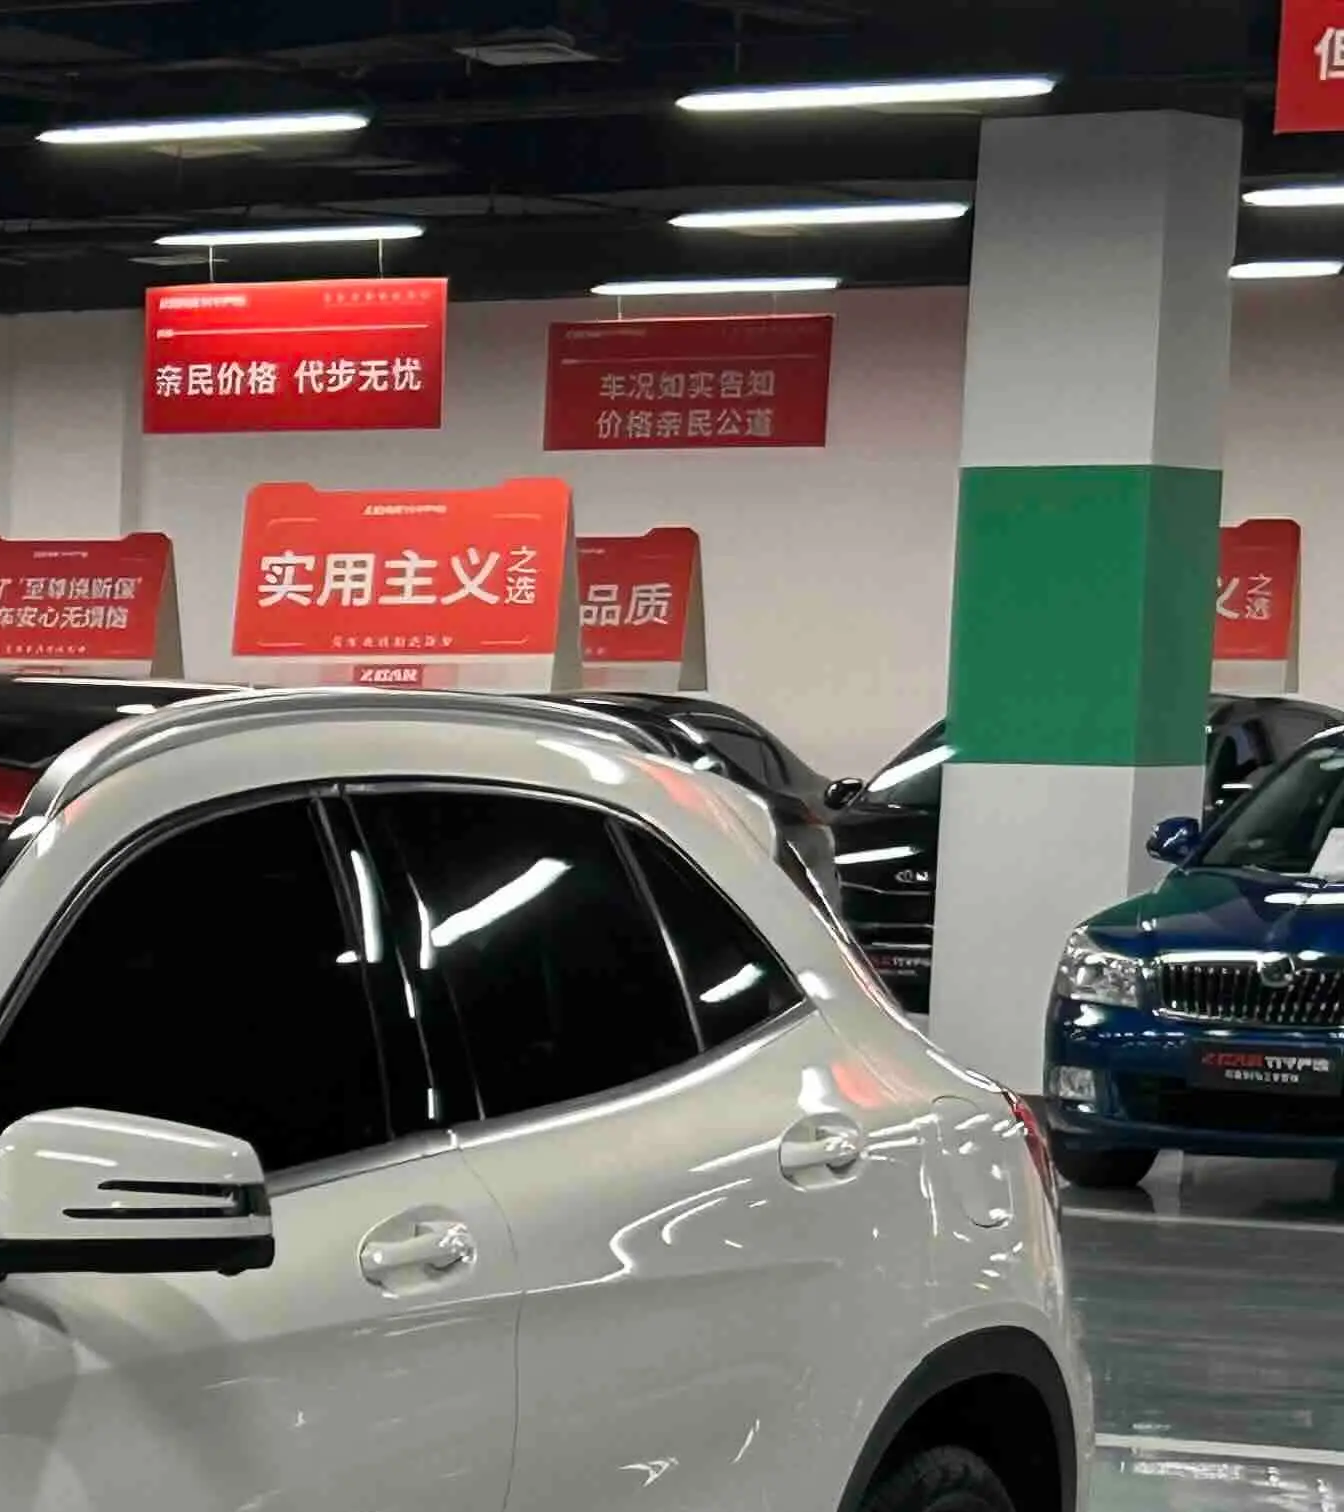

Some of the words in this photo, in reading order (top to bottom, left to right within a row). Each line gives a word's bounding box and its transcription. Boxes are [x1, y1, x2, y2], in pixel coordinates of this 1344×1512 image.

[156, 361, 277, 398] 亲民价格
[293, 357, 423, 394] 代步无忧
[257, 547, 501, 608] 实用主义
[504, 546, 538, 606] 之选
[579, 582, 672, 626] 品质
